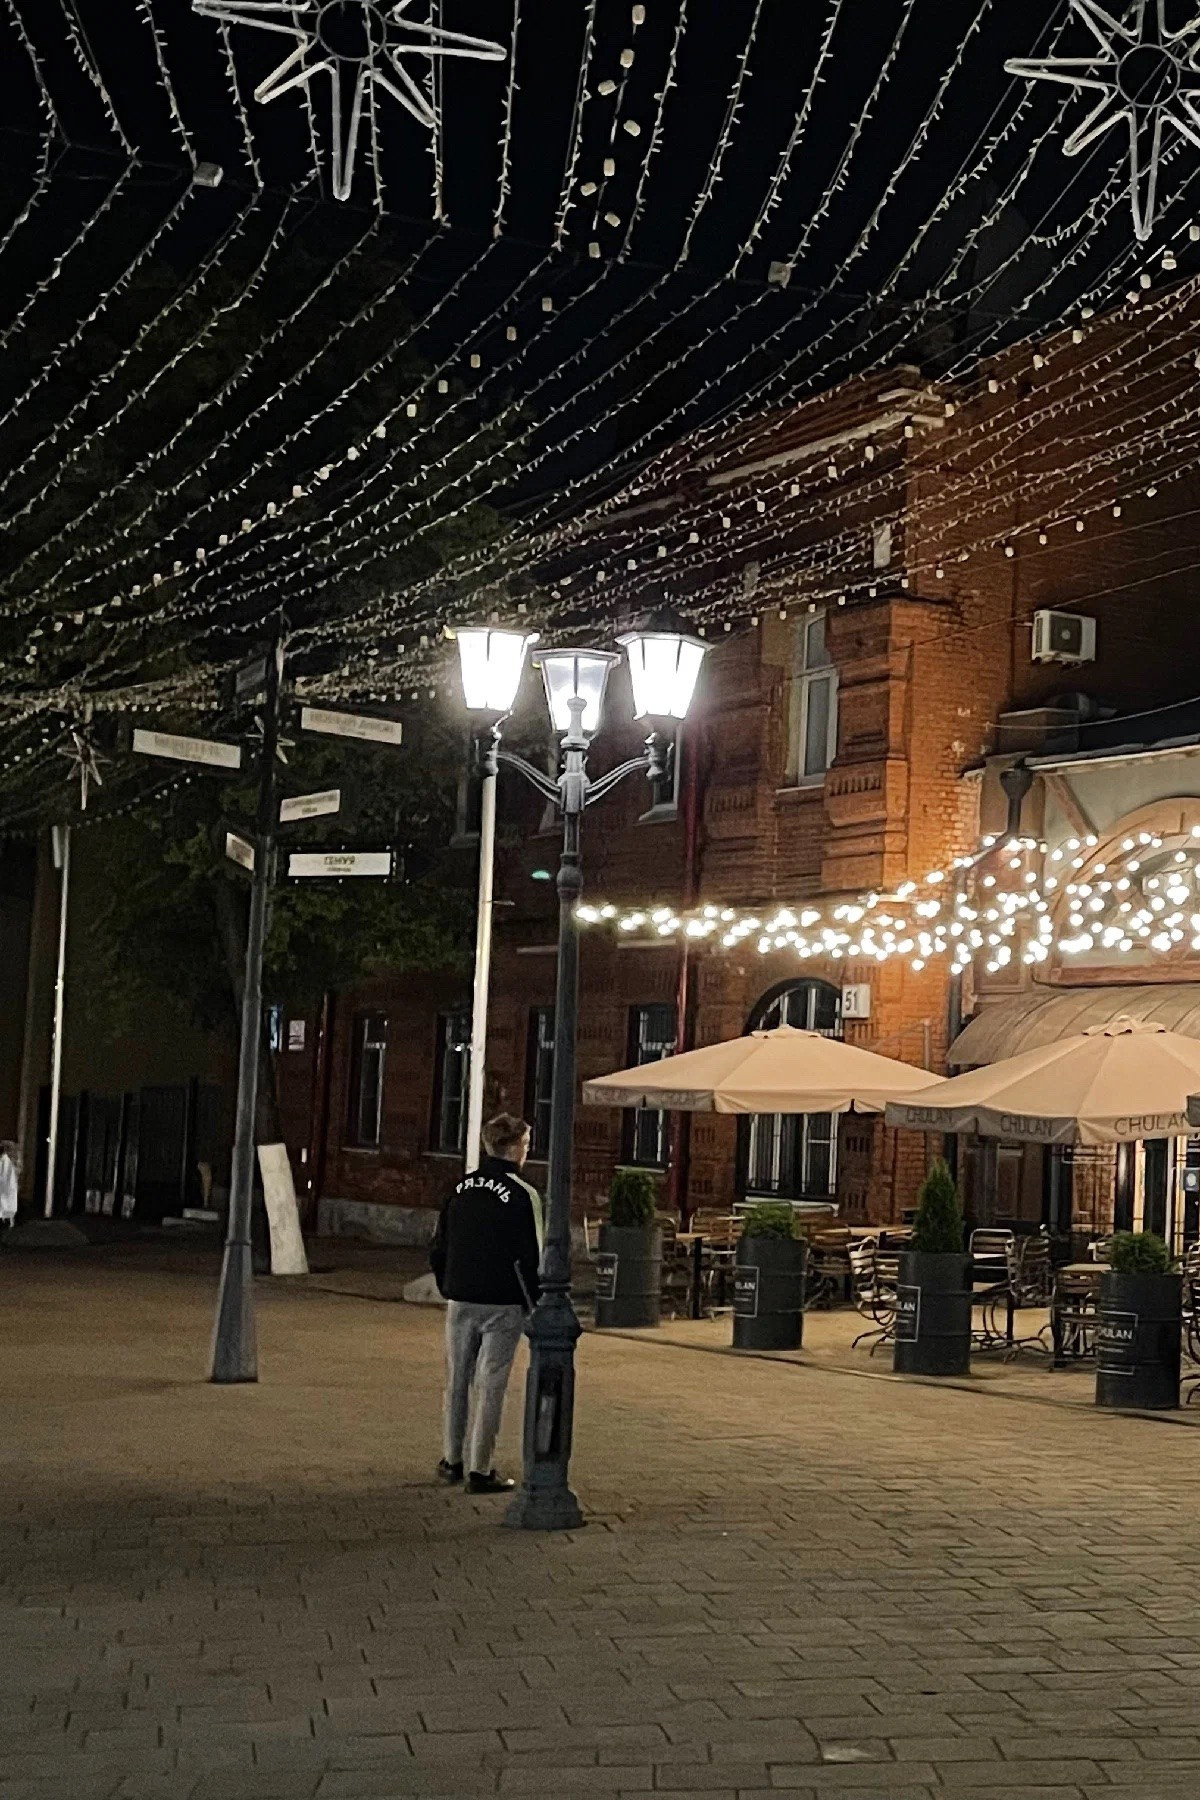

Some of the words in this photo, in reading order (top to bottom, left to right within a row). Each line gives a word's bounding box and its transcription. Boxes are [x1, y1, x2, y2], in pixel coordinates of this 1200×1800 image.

[844, 990, 858, 1011] 51
[1000, 1115, 1052, 1136] CHULAN
[456, 1176, 511, 1203] РЯЗАНЬ
